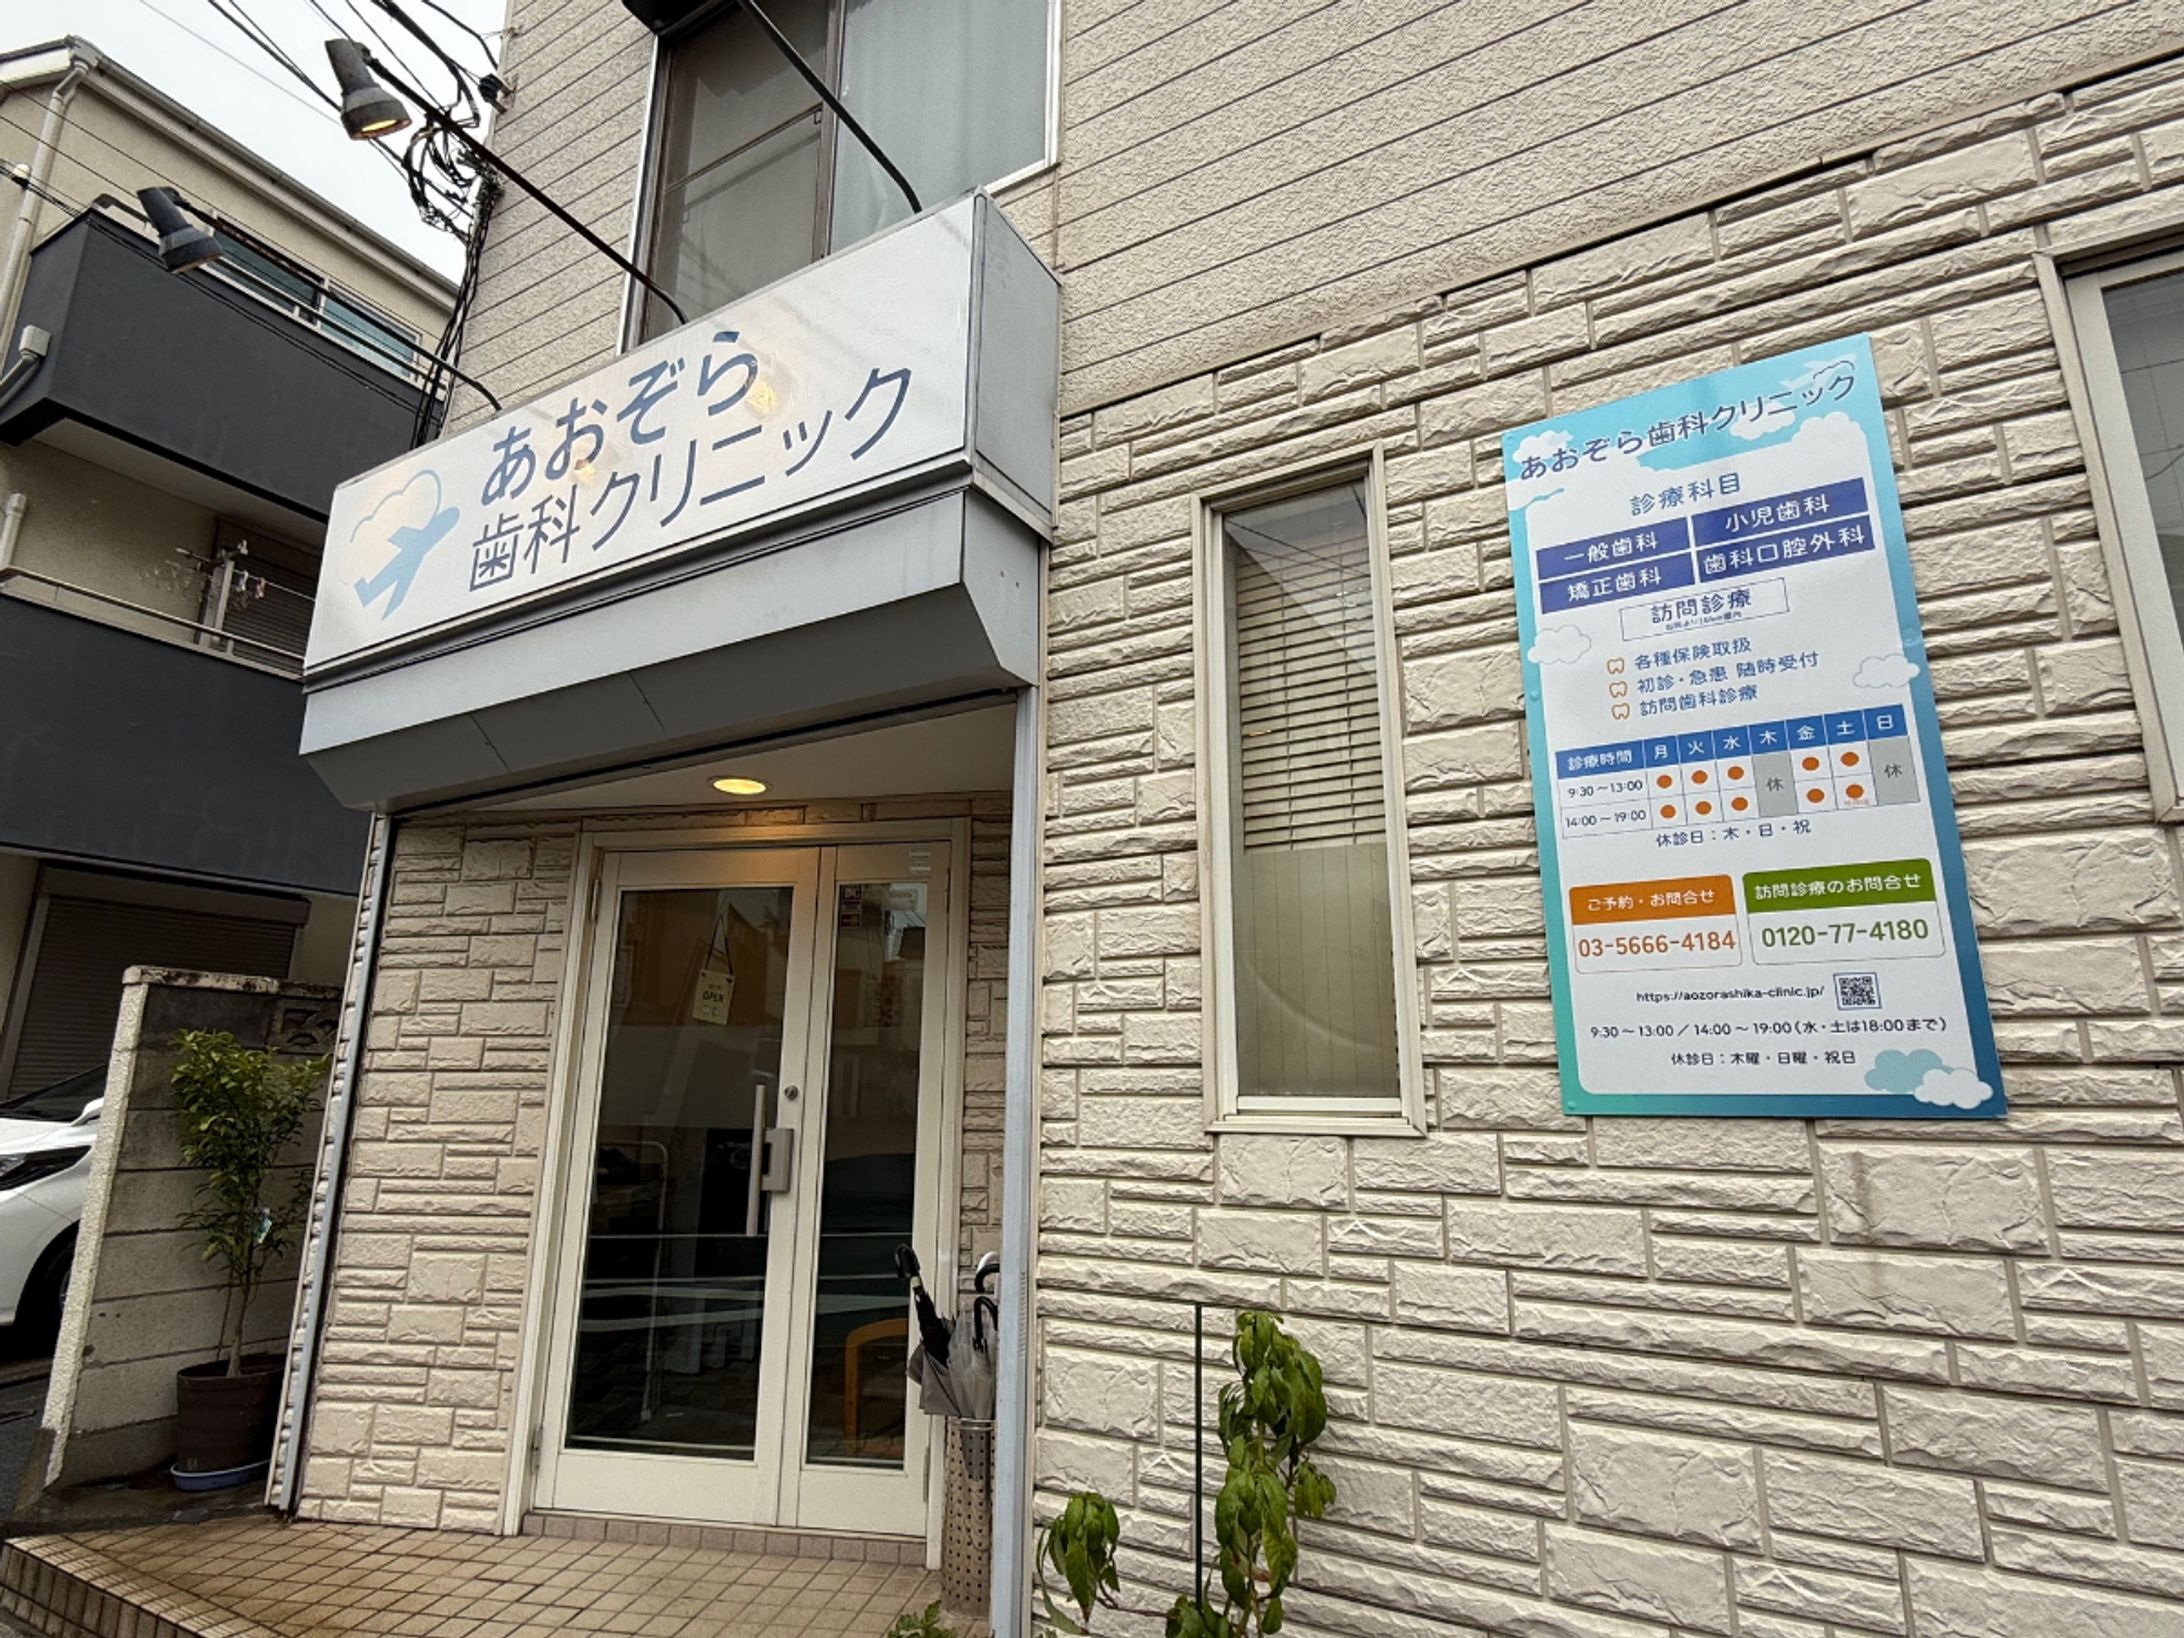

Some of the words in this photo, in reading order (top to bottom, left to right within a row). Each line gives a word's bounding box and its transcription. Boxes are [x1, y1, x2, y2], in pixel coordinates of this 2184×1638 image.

[482, 331, 760, 507] あおぞら
[1520, 374, 1856, 481] あおぞら歯科クリニック
[469, 366, 912, 593] 歯科クリニック
[1629, 472, 1742, 517] 診療科目
[1724, 493, 1830, 533] 小児歯科
[1563, 531, 1659, 565] 一般歯科
[1702, 525, 1866, 576] 歯科口腔外科
[1566, 566, 1662, 603] 矯正歯科
[1650, 588, 1752, 624] 訪問診療
[1634, 636, 1752, 672] 各種保険取扱
[1637, 665, 1729, 694] 初診・急患
[1736, 650, 1820, 680] 随時受付
[1639, 684, 1759, 717] 訪問歯科診療
[1567, 749, 1633, 771] 診療時間
[1654, 744, 1669, 761] 月
[1687, 740, 1705, 756] 火
[1723, 735, 1742, 751] 水
[1758, 729, 1778, 746] 木
[1796, 724, 1816, 742] 金
[1836, 719, 1856, 736] 土
[1876, 714, 1894, 731] 日
[1766, 776, 1785, 792] 休
[1884, 762, 1903, 779] 休
[1587, 888, 1716, 912] ご予約・お問合せ
[1754, 872, 1921, 900] 訪問診療のお問合せ
[1578, 929, 1736, 958] 03-5666-4184
[1761, 918, 1929, 949] 0120-77-4180
[1636, 985, 1825, 1003] https://aozorashika-clinic.jp/
